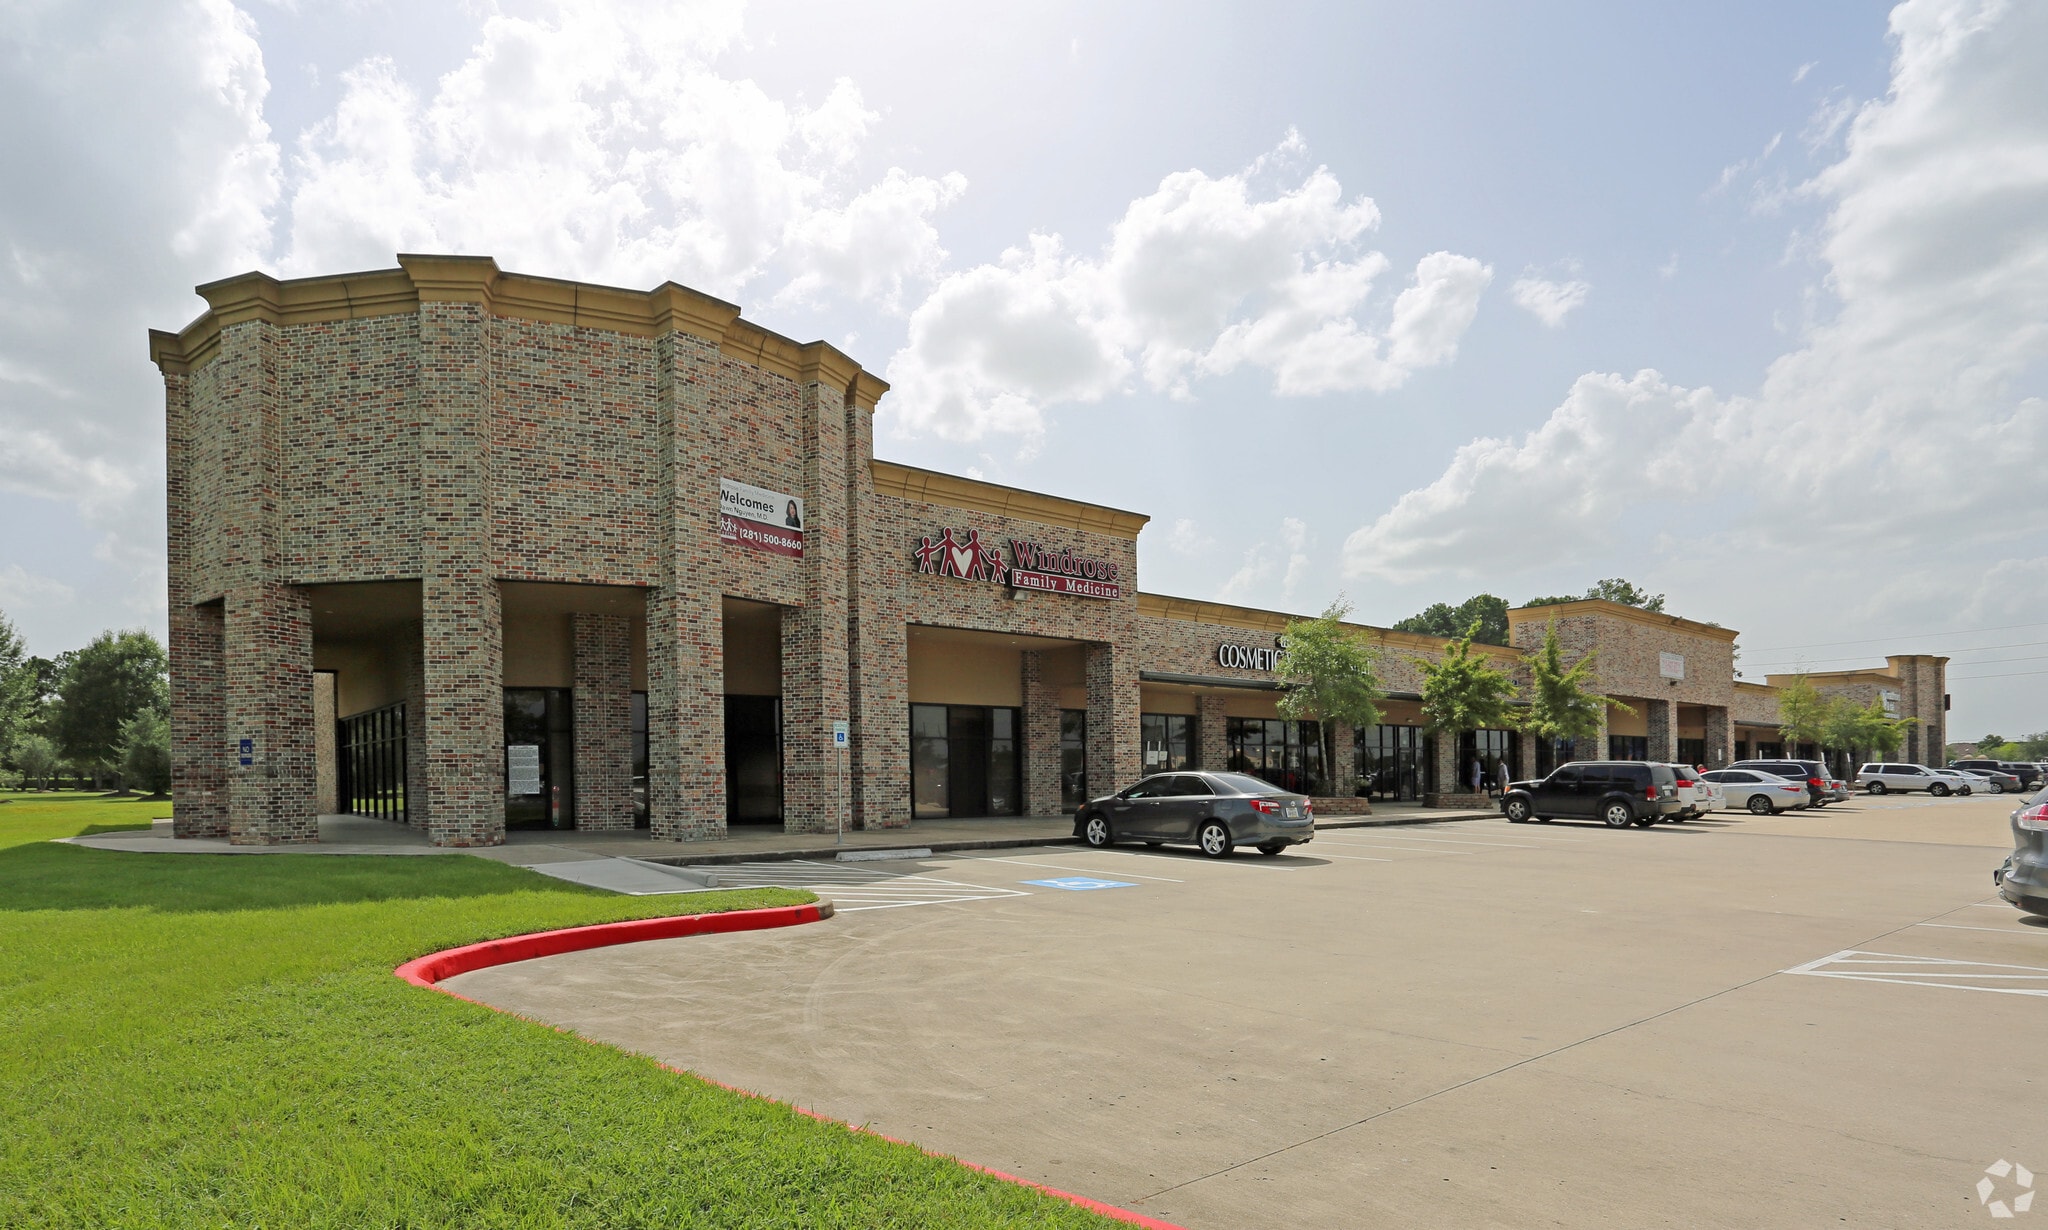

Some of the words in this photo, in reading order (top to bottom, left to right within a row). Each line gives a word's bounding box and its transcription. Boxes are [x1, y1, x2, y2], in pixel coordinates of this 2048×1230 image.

[739, 528, 762, 543] (281)
[763, 534, 802, 550] 500-8660
[1011, 539, 1118, 580] Windrose
[1014, 572, 1057, 589] Family
[1066, 579, 1118, 597] Medicine
[1219, 644, 1282, 671] COSMETIC
